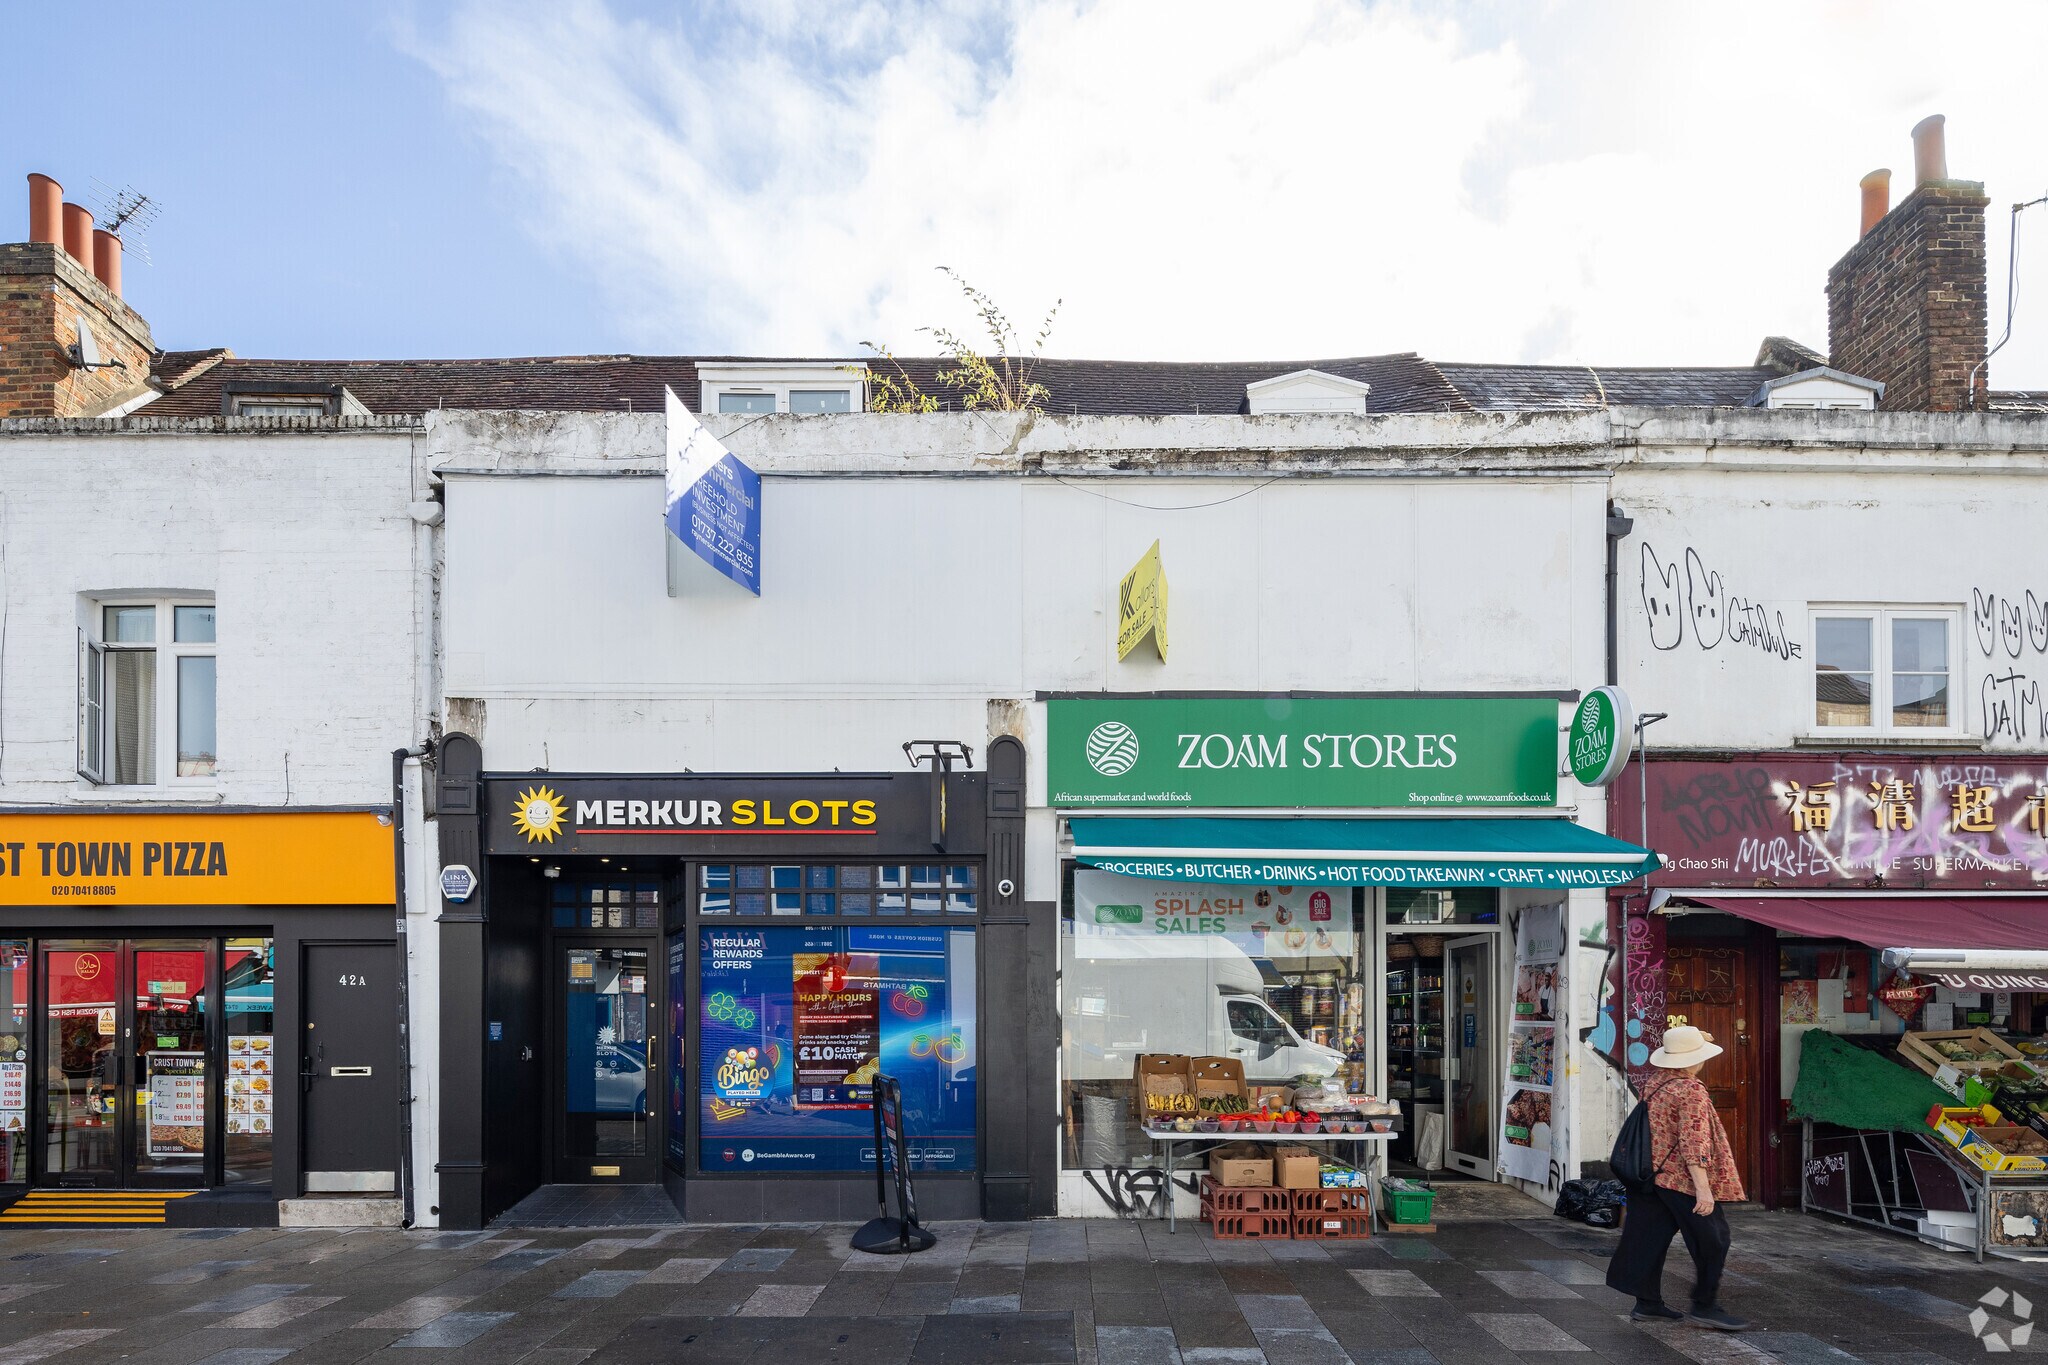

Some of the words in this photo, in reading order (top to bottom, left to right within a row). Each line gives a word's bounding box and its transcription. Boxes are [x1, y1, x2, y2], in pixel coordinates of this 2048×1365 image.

[697, 478, 738, 516] REEHOLD
[692, 486, 745, 535] INVESTMENT
[691, 500, 717, 528] (BUSINESS
[717, 520, 728, 536] NOT
[727, 529, 755, 553] AFFECTED)
[691, 515, 716, 543] 01737
[717, 537, 735, 558] 222
[736, 547, 754, 569] 835
[691, 529, 754, 577] raynerscommercial.com
[1119, 628, 1130, 646] FOR
[1131, 610, 1147, 635] SALE
[1575, 726, 1607, 758] ZOAM
[1177, 734, 1288, 769] ZOAM
[1302, 734, 1457, 769] STORES
[1575, 746, 1607, 771] STORES
[1054, 792, 1082, 801] African
[1084, 792, 1130, 804] supermarket
[1132, 792, 1146, 801] and
[1148, 792, 1169, 801] world
[1170, 792, 1191, 801] foods
[1408, 792, 1430, 804] Shop
[1430, 792, 1454, 801] online
[1455, 794, 1463, 803] @
[1466, 792, 1551, 802] www.zoamfoods.co.uk
[576, 800, 723, 825] MERKUR
[731, 799, 877, 825] SLOTS
[37, 842, 131, 876] TOWN
[143, 842, 228, 876] PIZZA
[1679, 858, 1708, 869] Chao
[1713, 858, 1729, 869] Shi
[1185, 864, 1252, 880] BUTCHER
[1263, 865, 1317, 881] DRINKS
[1327, 866, 1359, 881] HOT
[1362, 866, 1405, 882] FOOD
[1406, 867, 1485, 883] TAKEAWAY
[1498, 868, 1544, 883] CRAFT
[1556, 869, 1634, 885] WHOLESAL
[51, 885, 68, 896] 020
[69, 885, 91, 896] 7041
[93, 885, 116, 896] 8805
[1155, 898, 1244, 916] SPLASH
[1313, 898, 1326, 909] BIG
[1155, 917, 1226, 935] SALES
[713, 938, 761, 947] REGULAR
[713, 949, 763, 958] REWARDS
[713, 960, 752, 969] OFFERS
[339, 974, 367, 986] 42A
[800, 994, 833, 1002] HAPPY
[836, 994, 872, 1002] HOURS
[799, 1046, 834, 1060] £10
[1, 1063, 9, 1071] Any
[153, 1058, 174, 1067] CRUST
[174, 1058, 195, 1067] TOWN
[718, 1064, 769, 1090] Bingo
